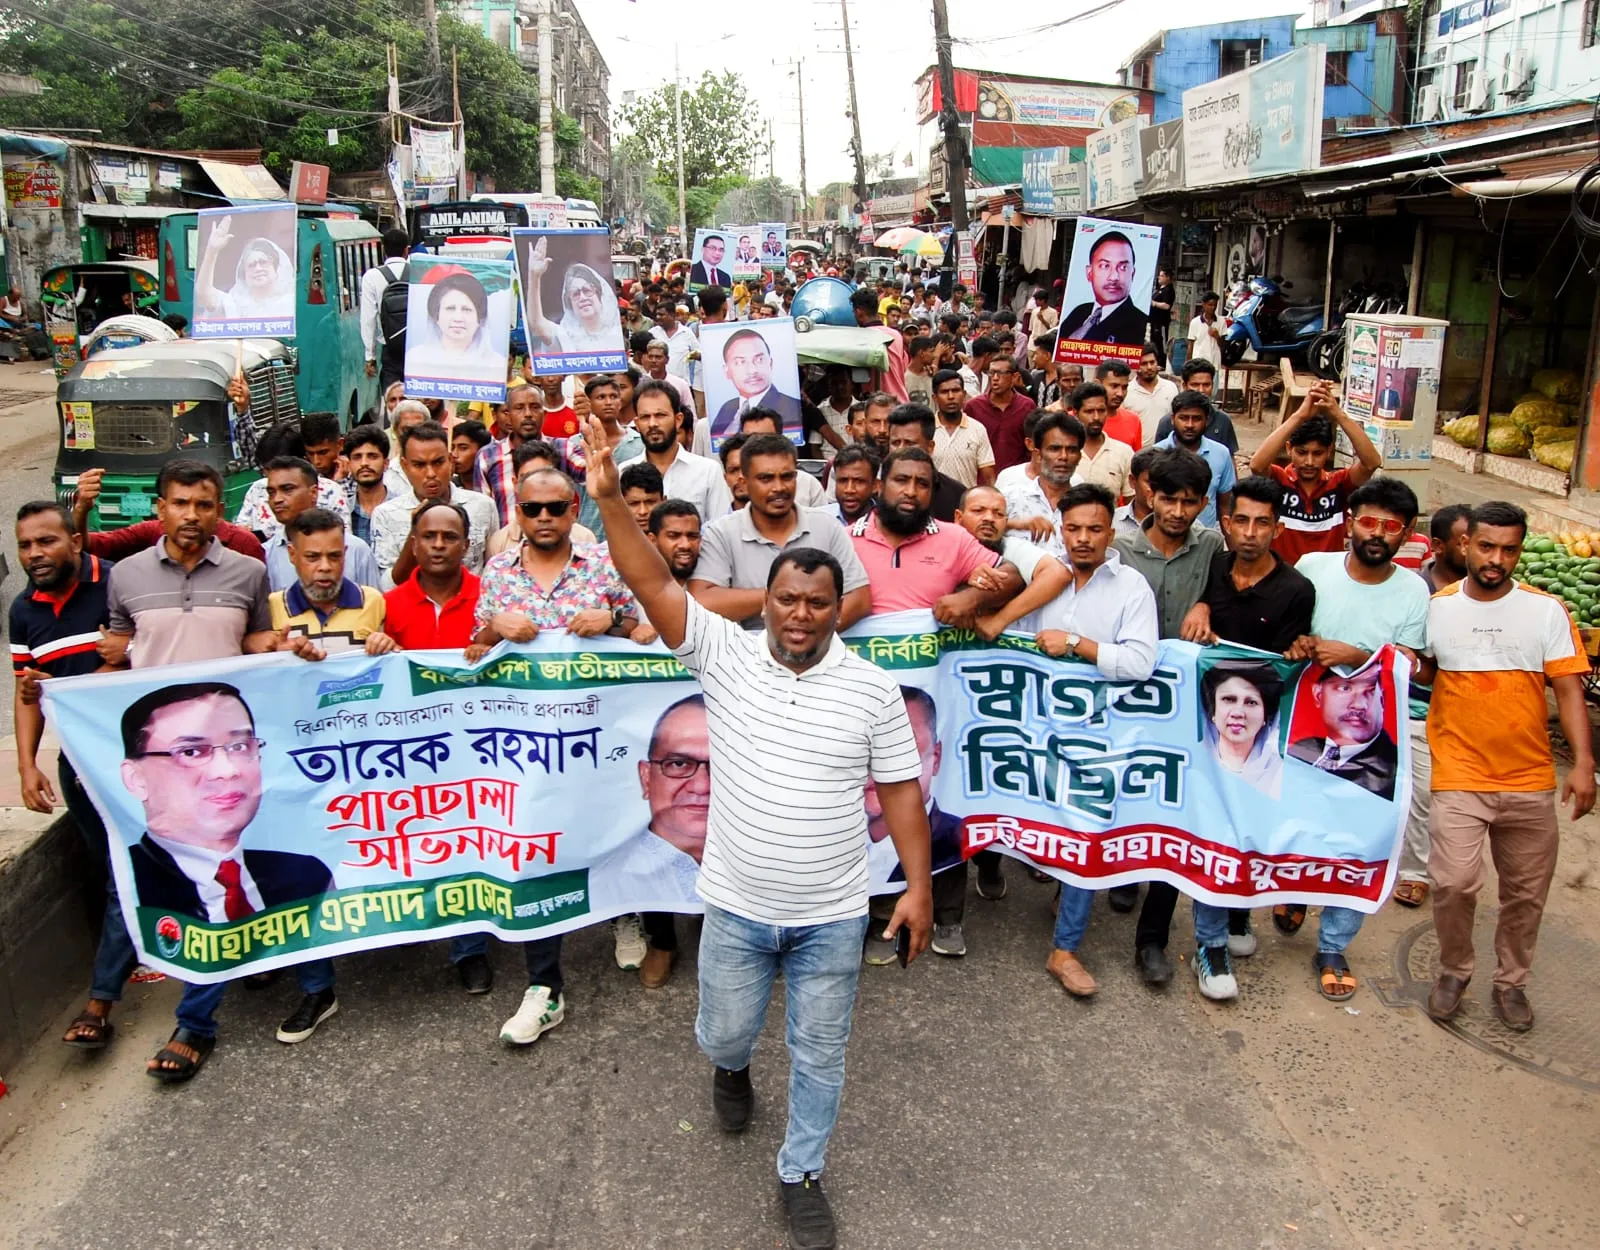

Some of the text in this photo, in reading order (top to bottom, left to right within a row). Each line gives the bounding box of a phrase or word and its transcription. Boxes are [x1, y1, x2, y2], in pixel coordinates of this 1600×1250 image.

[430, 211, 506, 226] ANIL ANIMA
[535, 354, 624, 369] চট্টগ্রাম মহানগর যুবদল
[406, 379, 501, 397] চট্টগ্রাম মহানগর যুবদল
[1282, 492, 1300, 507] 19
[539, 653, 692, 682] জাতীয়তাবাদ
[867, 634, 940, 664] নির্বাহী
[294, 694, 602, 736] বিএনপির চেয়ারম্যান ও মাননীয় প্রধানমন্ত্রী
[960, 663, 1178, 726] স্বাগত
[286, 731, 454, 784] তারেক
[464, 726, 603, 776] রহমান
[962, 725, 1185, 820] মিছিল
[326, 778, 520, 832] প্রাণঢালা
[340, 814, 564, 878] অভিনন্দন
[966, 816, 1380, 891] চট্টগ্রাম মহানগর যুবদল
[183, 904, 310, 963] মোহাম্মদ
[320, 888, 425, 934] এরশাদ
[435, 878, 513, 920] হোসেন
